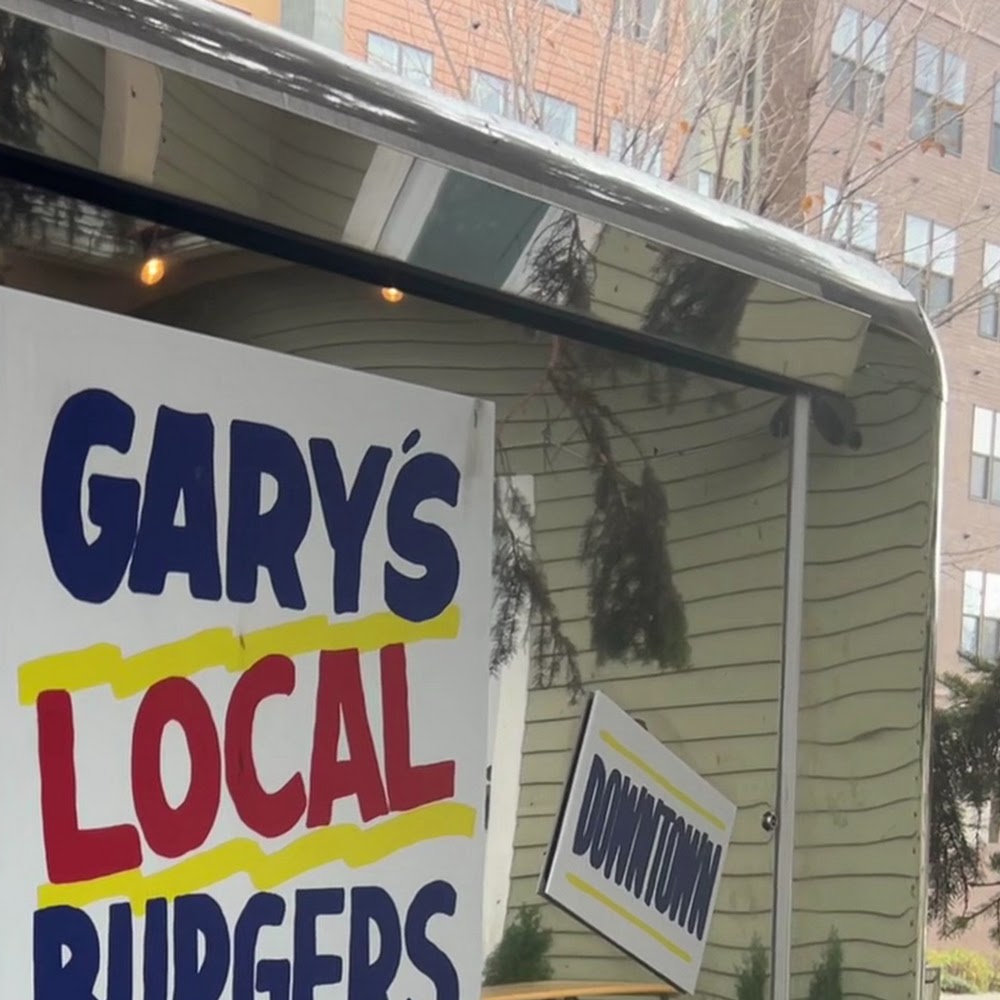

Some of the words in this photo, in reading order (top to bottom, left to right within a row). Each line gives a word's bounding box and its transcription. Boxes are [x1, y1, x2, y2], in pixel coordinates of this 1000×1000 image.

[41, 387, 461, 623] GARY'S
[37, 642, 455, 884] LOCAL
[572, 754, 722, 941] DOWNTOWN
